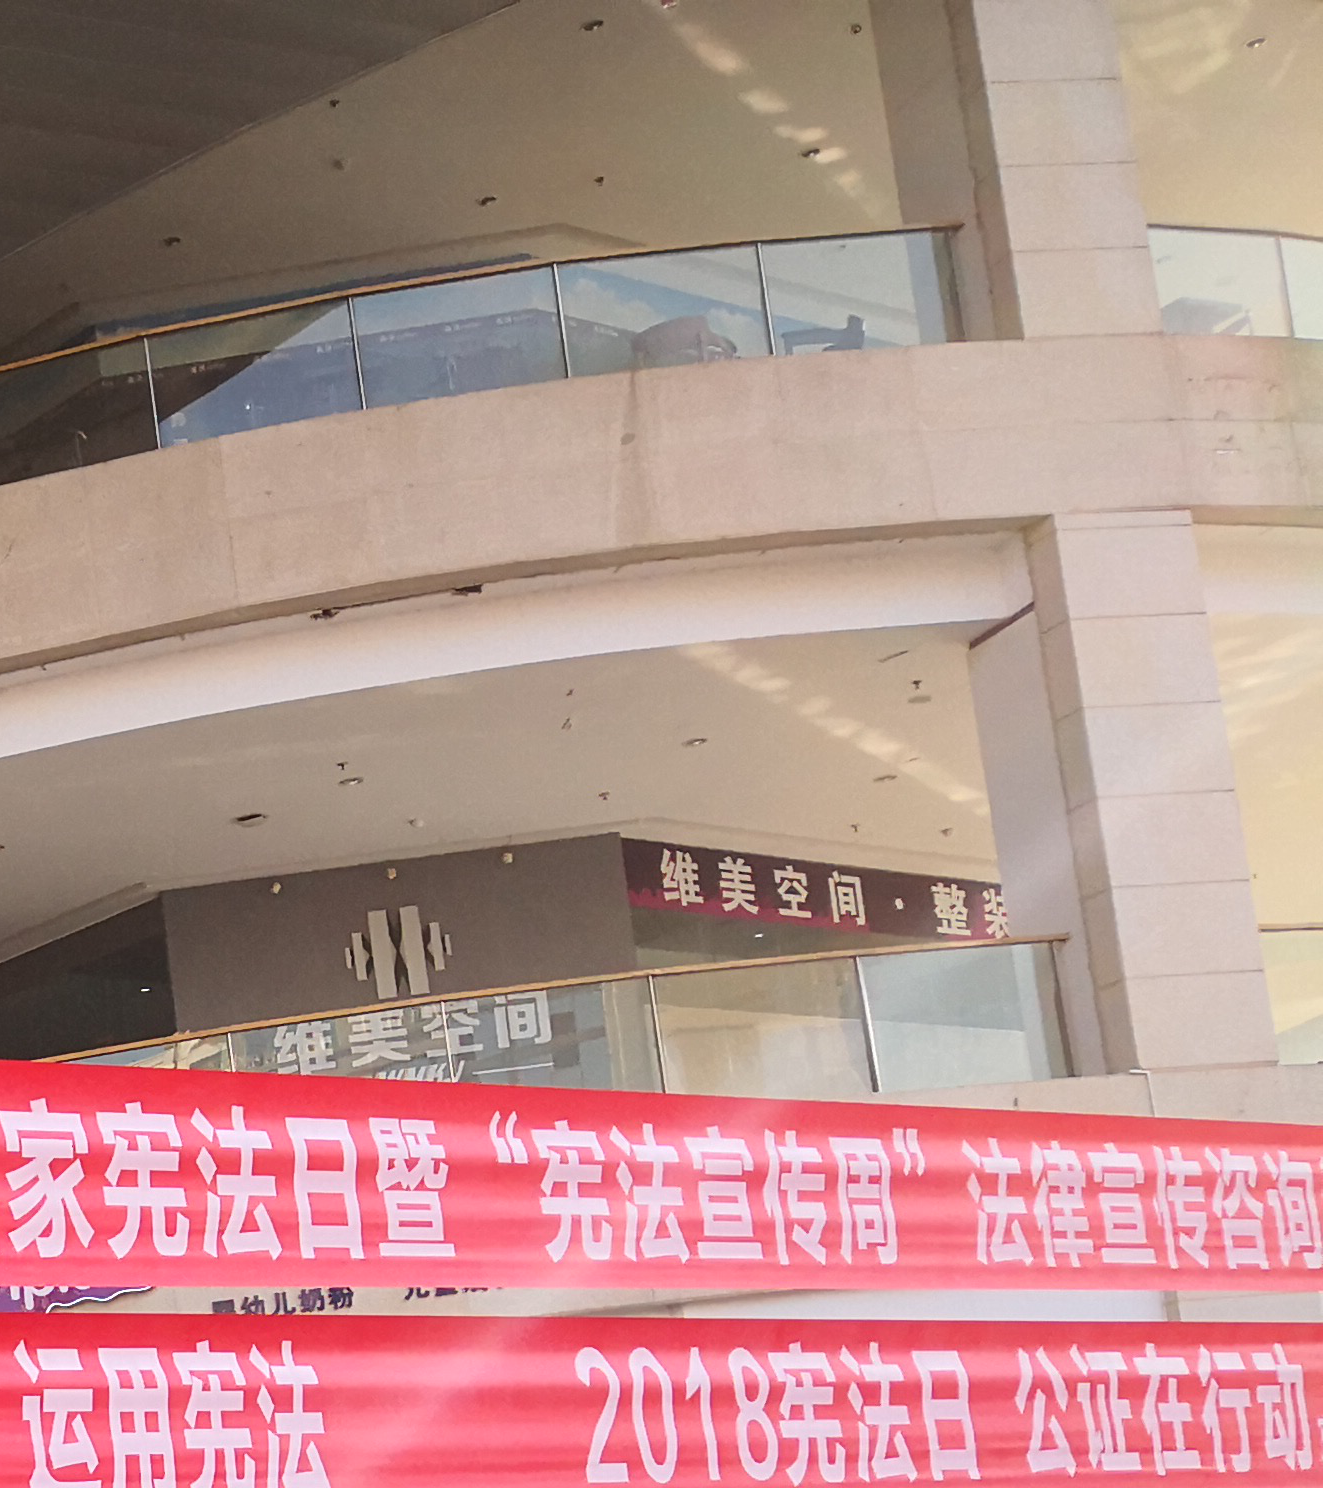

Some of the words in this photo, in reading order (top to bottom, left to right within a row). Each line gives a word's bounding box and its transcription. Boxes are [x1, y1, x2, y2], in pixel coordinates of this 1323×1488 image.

[274, 990, 554, 1077] 维美空间
[575, 1342, 982, 1487] 2018宪法日
[1016, 1343, 1313, 1478] 公证在行动
